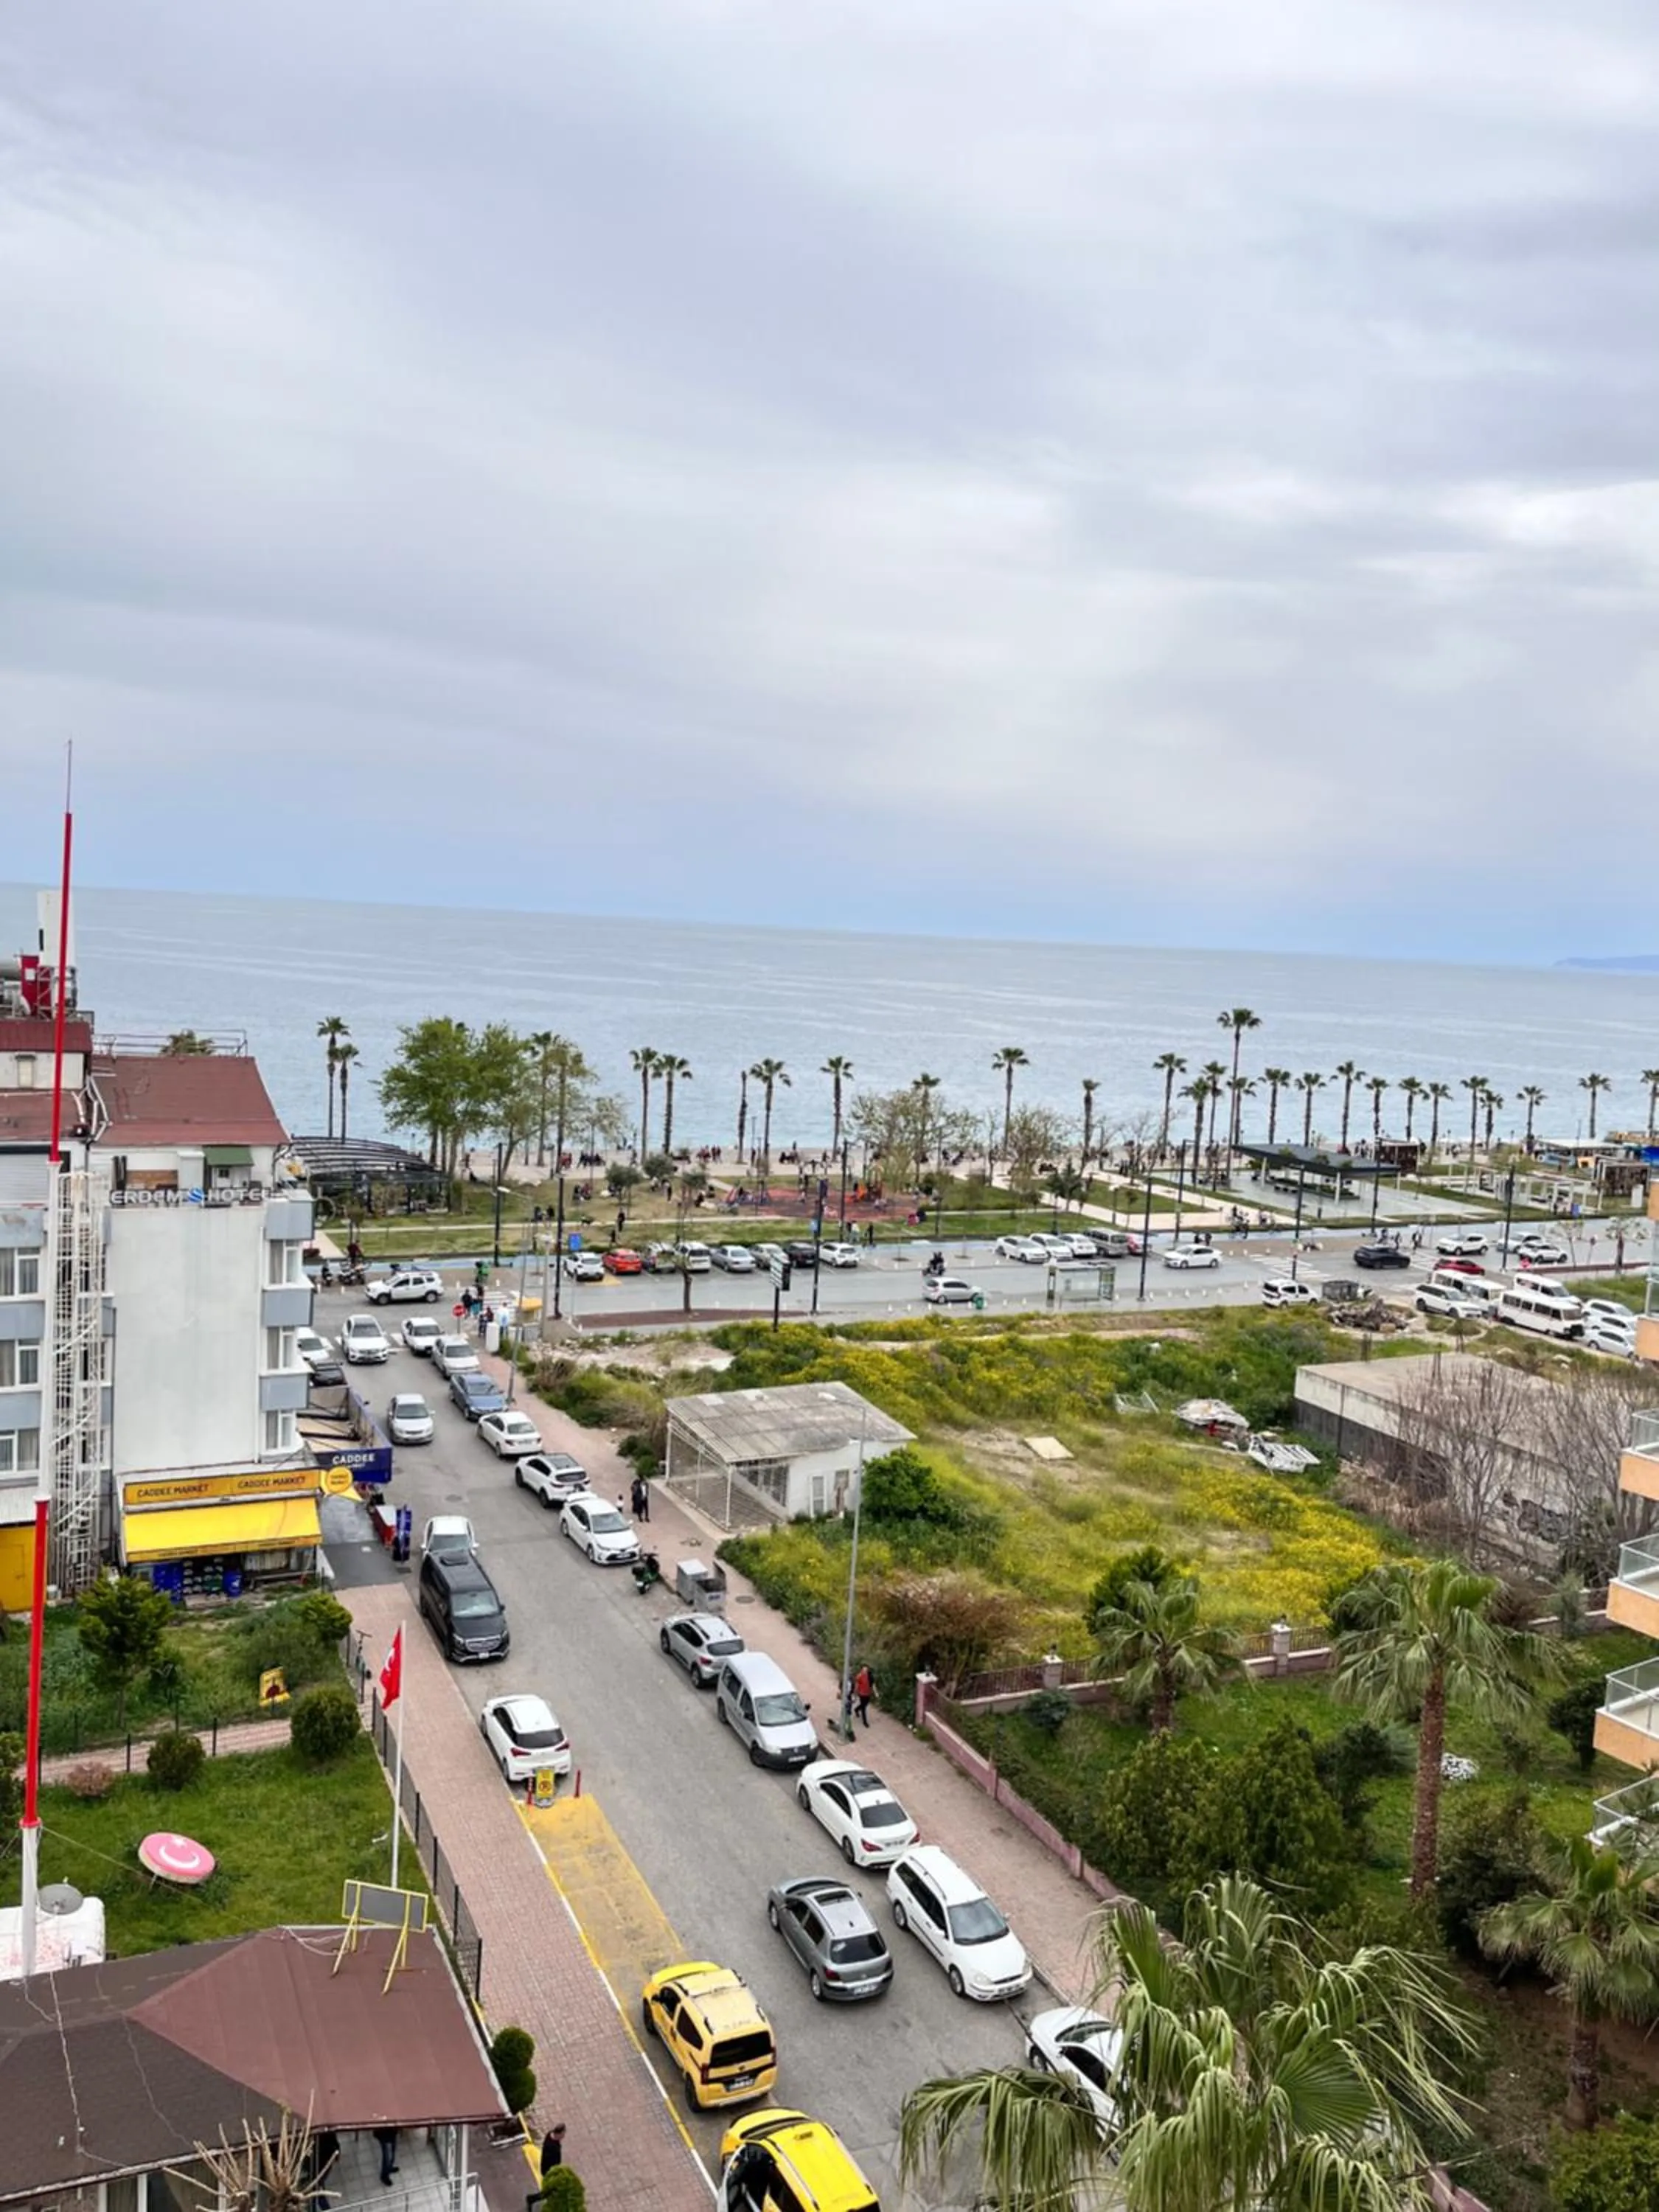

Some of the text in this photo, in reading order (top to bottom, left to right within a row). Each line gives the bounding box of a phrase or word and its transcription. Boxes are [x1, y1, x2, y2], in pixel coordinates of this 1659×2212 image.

[207, 1188, 271, 1203] HOTEL
[332, 1453, 376, 1465] CADDEE
[272, 1475, 306, 1487] MARKET
[173, 1483, 209, 1496] MARKET
